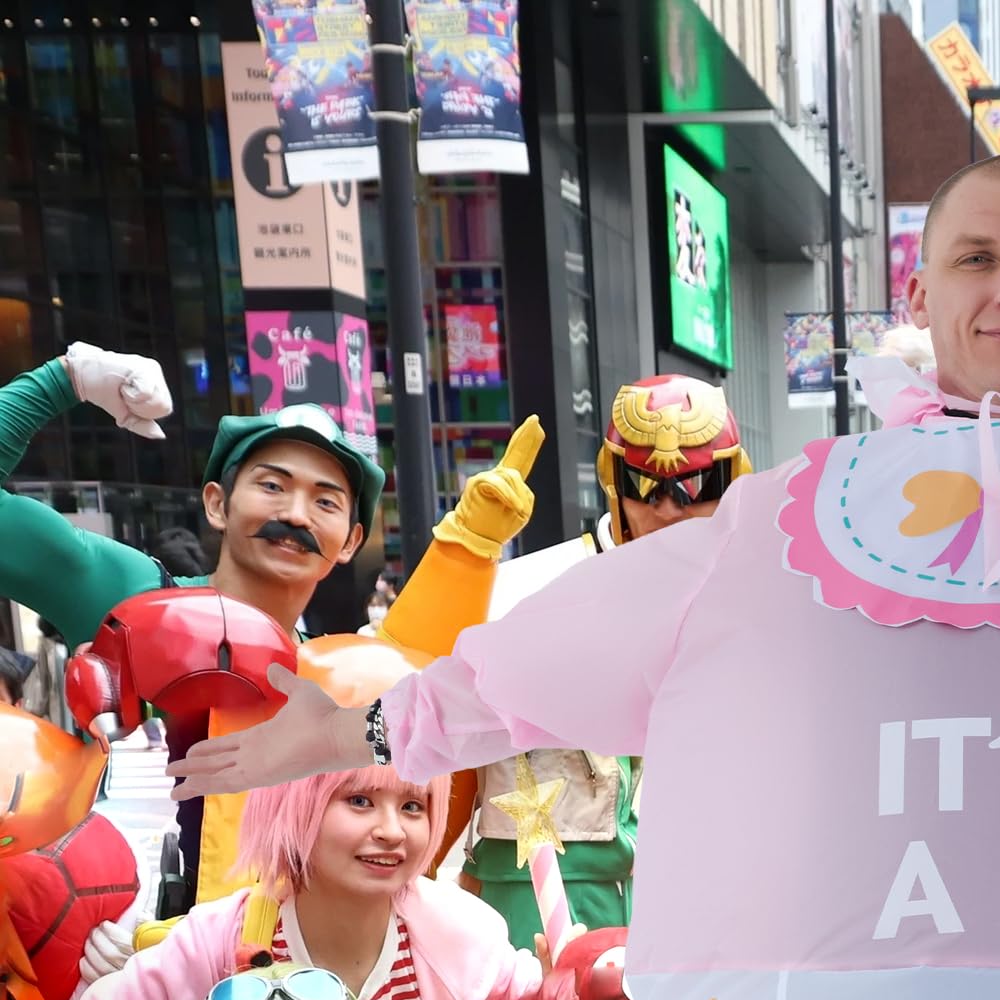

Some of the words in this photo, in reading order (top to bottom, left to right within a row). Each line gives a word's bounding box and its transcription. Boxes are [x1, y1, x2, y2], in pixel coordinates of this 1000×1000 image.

[246, 68, 269, 79] Tou
[232, 91, 272, 102] inform
[254, 247, 311, 258] 観光案内所
[267, 325, 313, 342] Café
[872, 840, 965, 940] A
